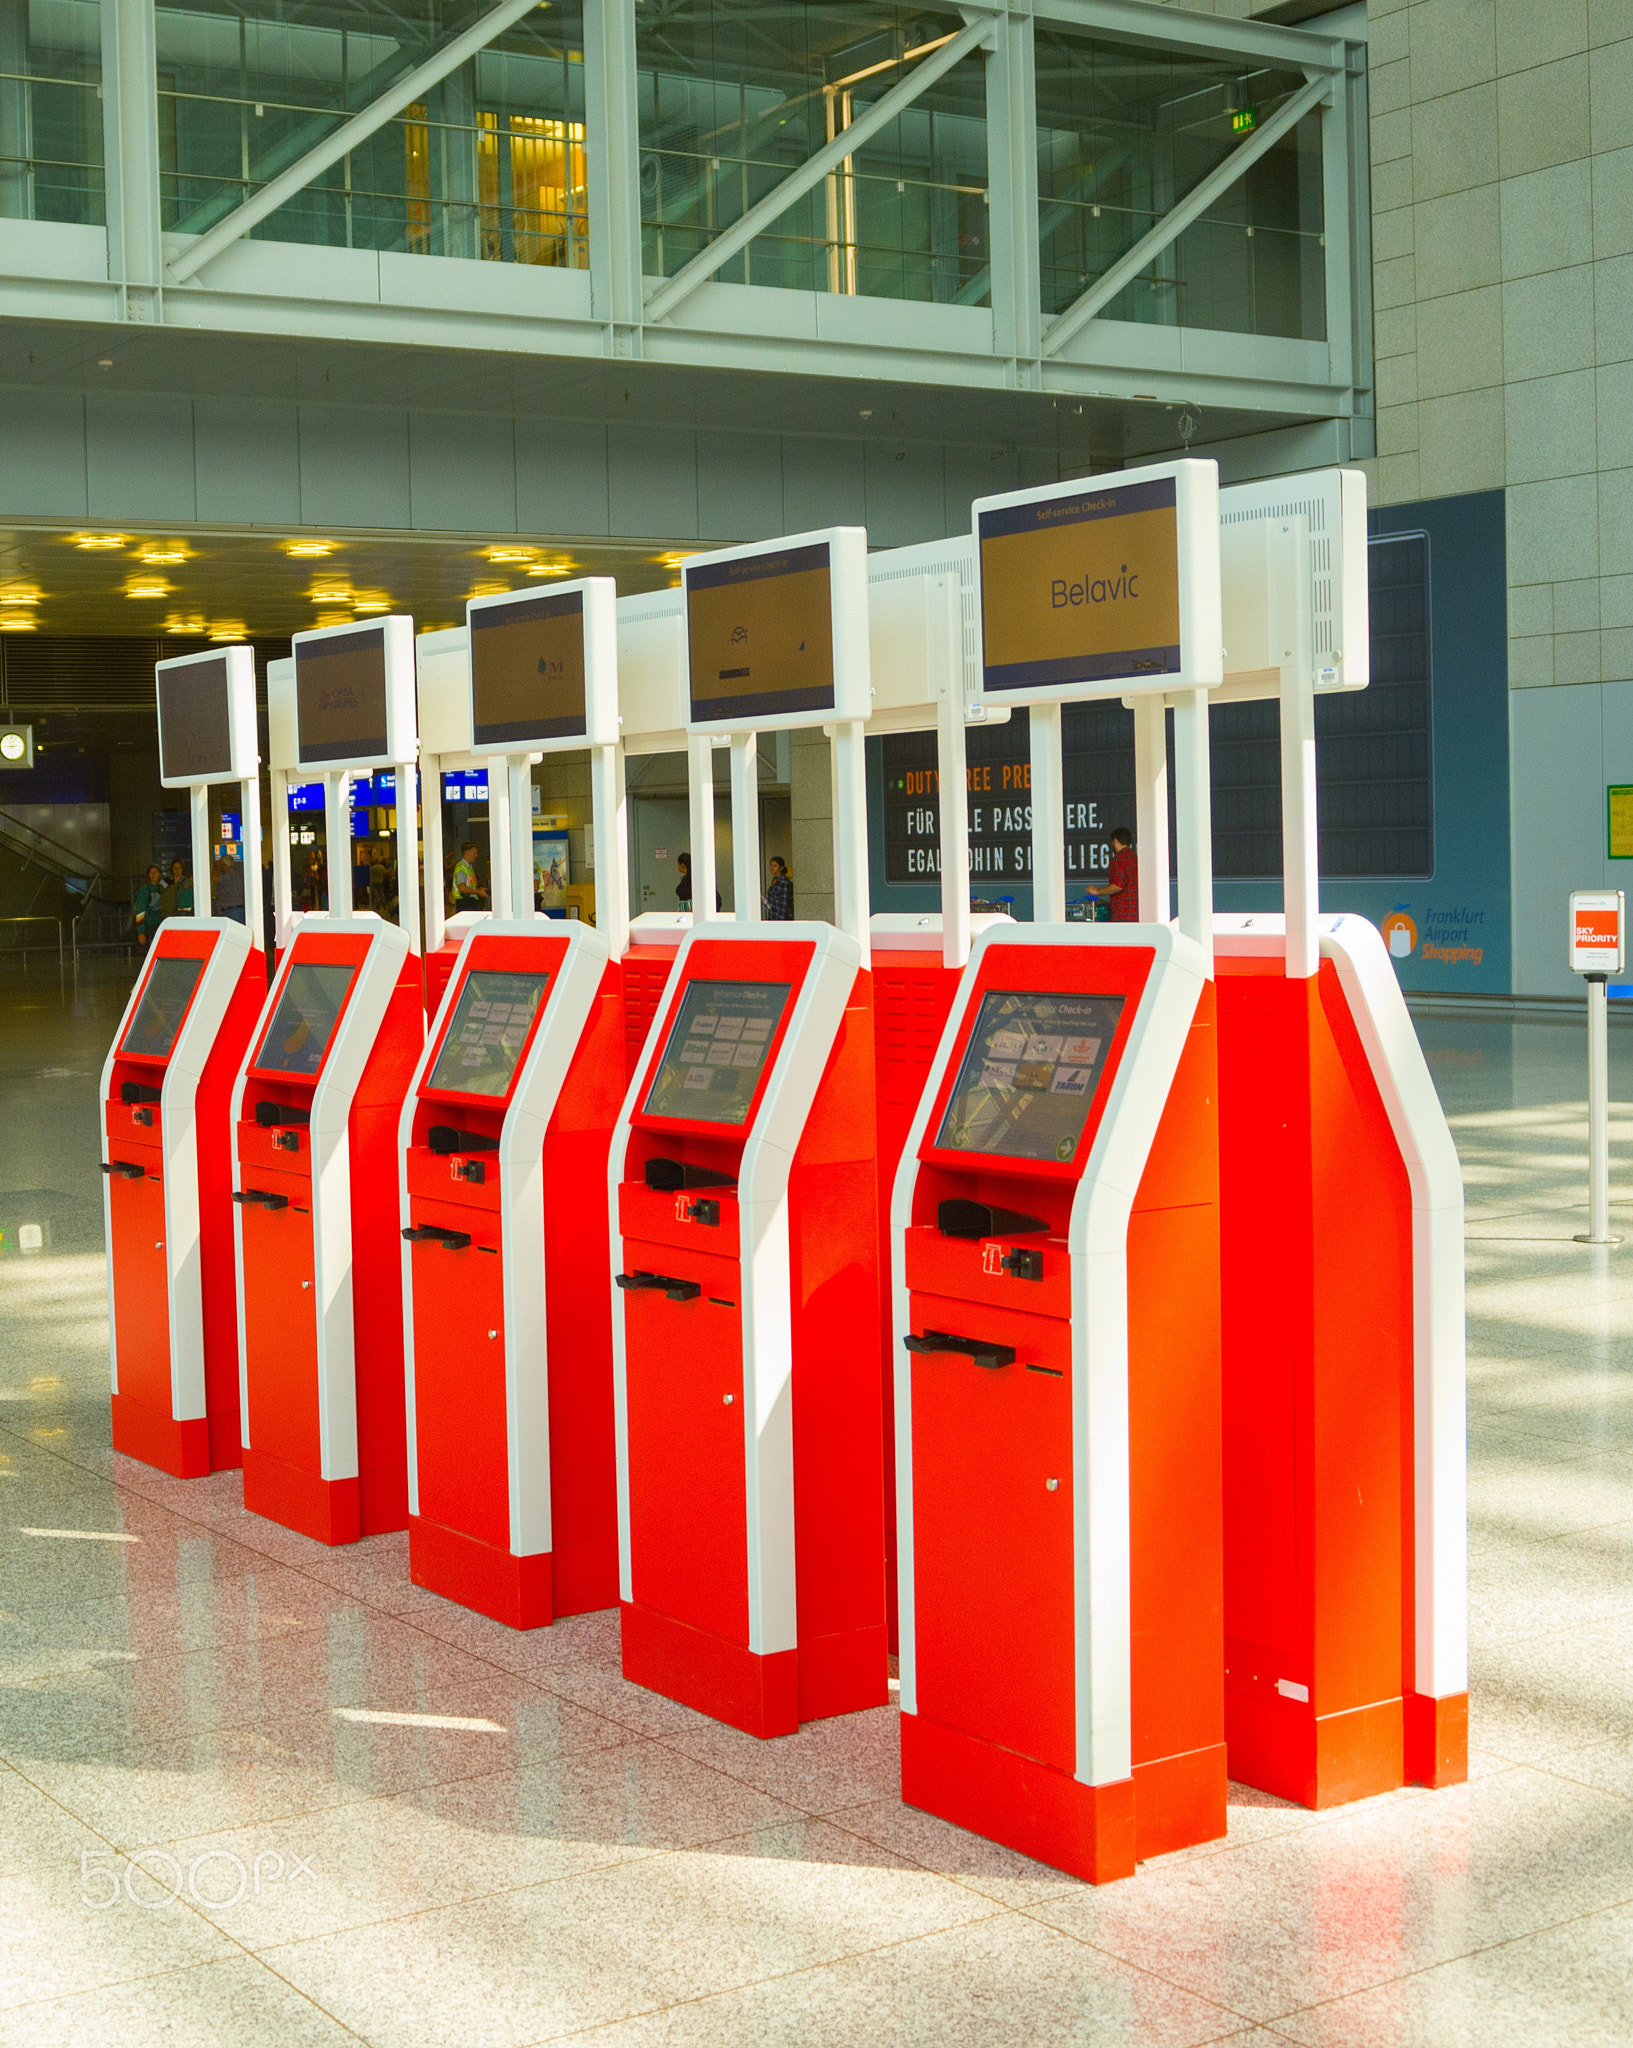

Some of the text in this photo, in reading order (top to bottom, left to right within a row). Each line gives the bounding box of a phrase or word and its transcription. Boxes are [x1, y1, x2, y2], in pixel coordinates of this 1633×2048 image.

[1036, 498, 1116, 521] Self-service Check-in
[966, 767, 991, 791] REE
[1003, 764, 1031, 790] PRE
[907, 808, 934, 834] FÜR
[968, 847, 1003, 871] OHIN
[1425, 908, 1484, 924] Frankfurt
[1424, 926, 1469, 943] Airport
[1576, 927, 1594, 935] SKY
[1576, 934, 1617, 943] PRIORITY
[1422, 943, 1483, 965] Shopping
[1058, 1004, 1092, 1015] Check-in
